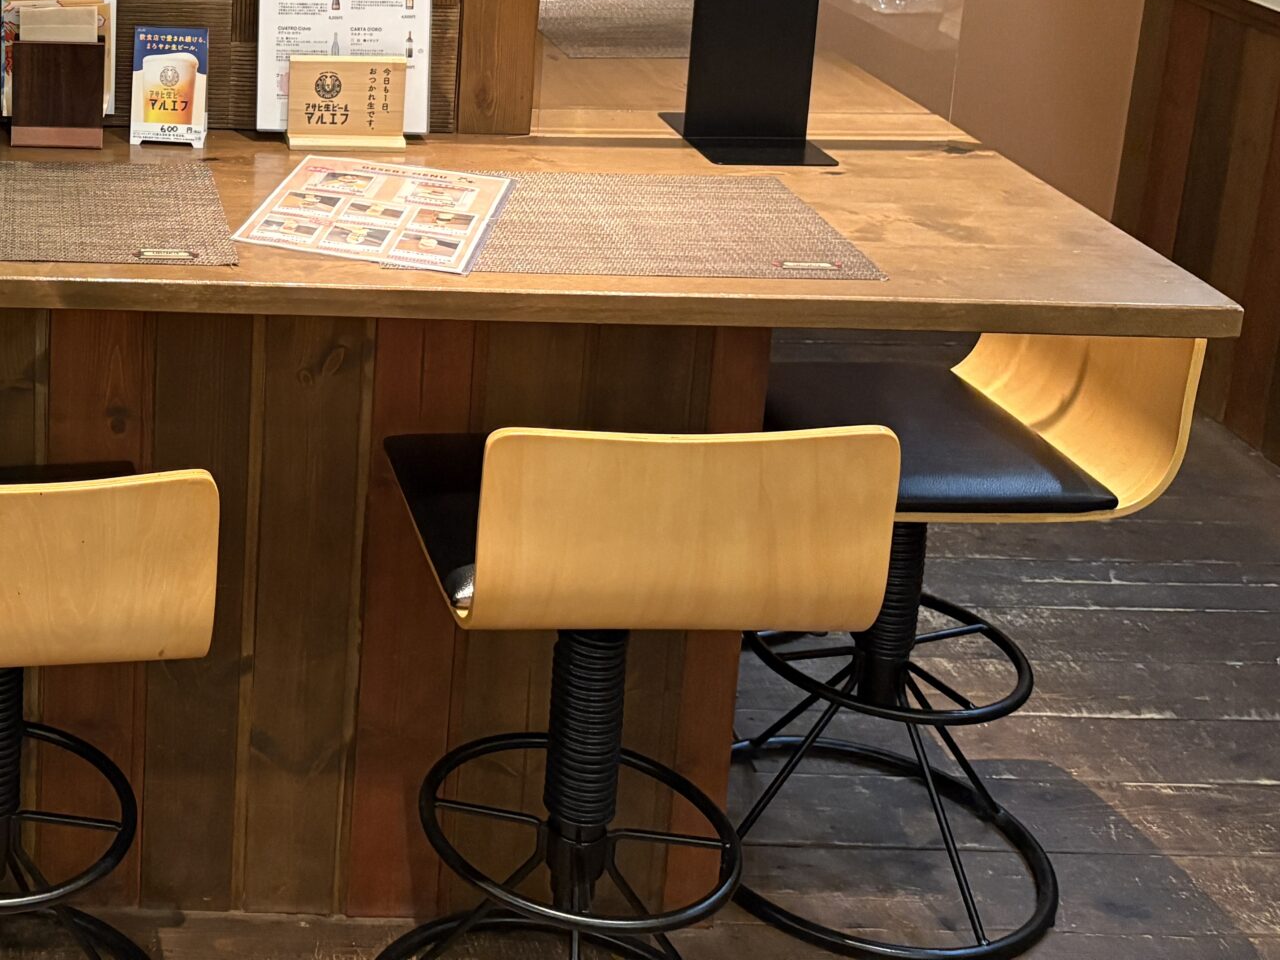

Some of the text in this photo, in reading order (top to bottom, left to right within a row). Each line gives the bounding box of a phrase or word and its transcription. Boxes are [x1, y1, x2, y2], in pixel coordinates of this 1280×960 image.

[149, 99, 188, 111] マルエフ
[366, 68, 377, 131] おつかれ生です。
[305, 103, 349, 112] アサヒ生ビール
[304, 112, 349, 125] マルエフ
